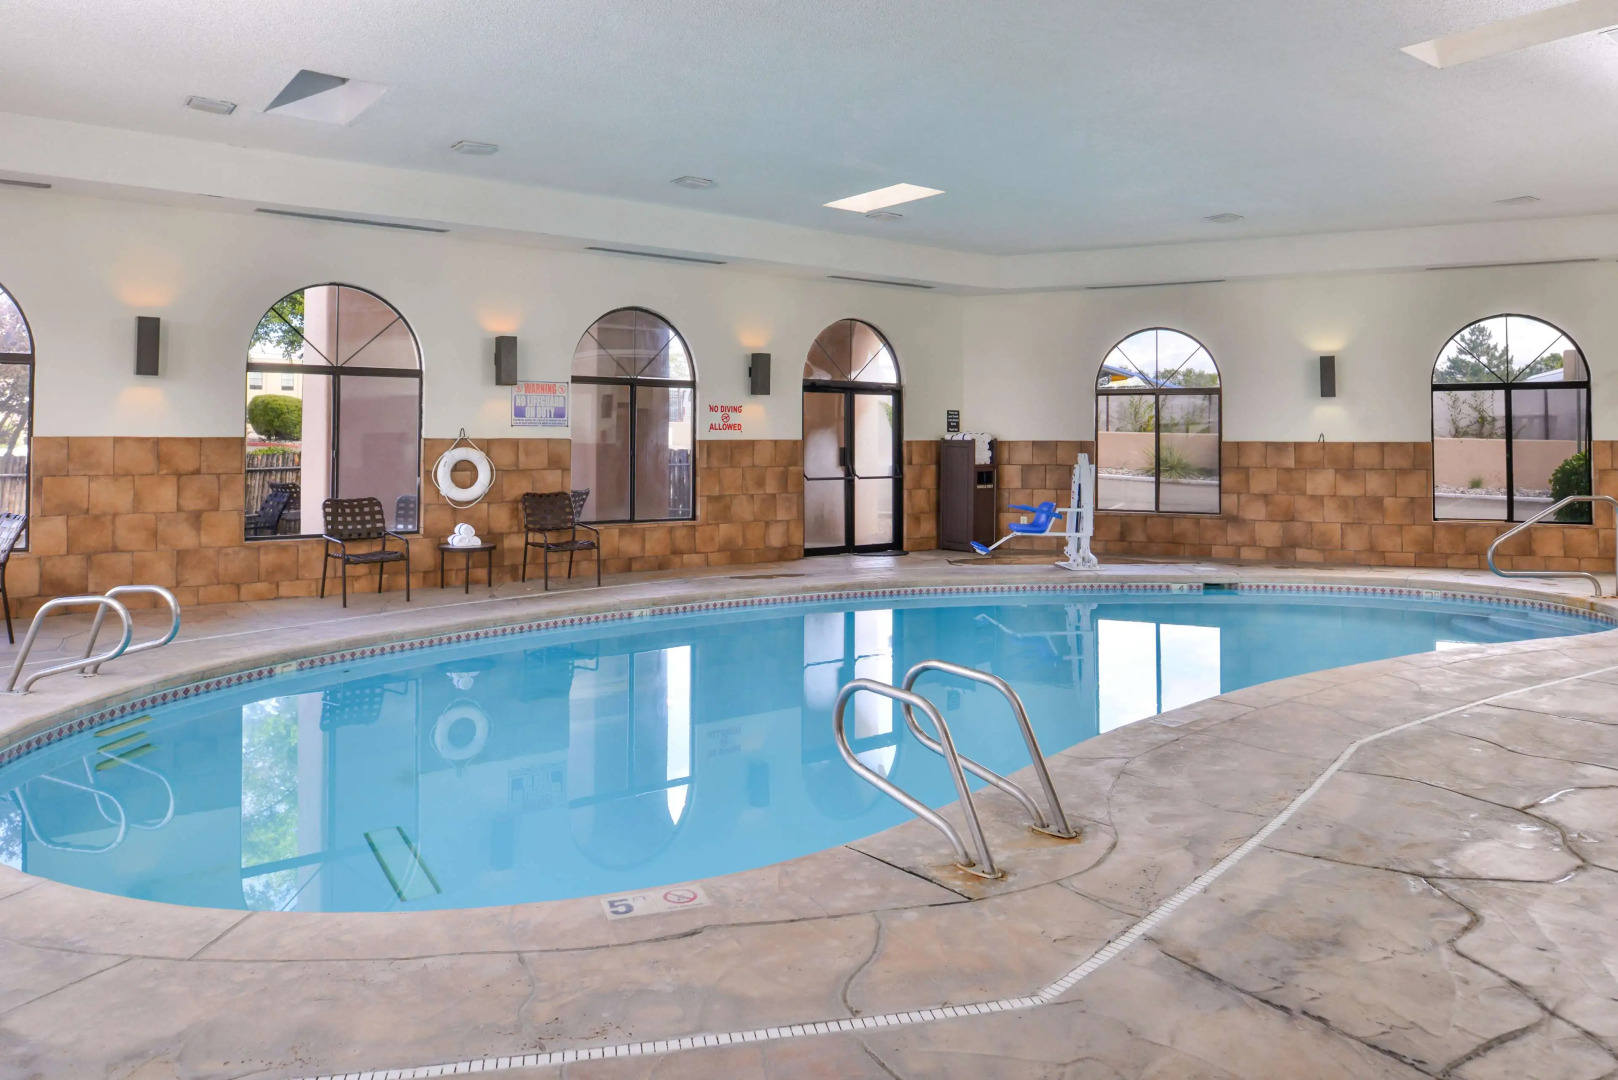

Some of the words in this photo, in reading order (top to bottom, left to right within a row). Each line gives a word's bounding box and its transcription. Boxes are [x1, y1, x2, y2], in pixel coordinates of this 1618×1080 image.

[524, 383, 557, 394] WARNING
[515, 395, 526, 406] NO
[527, 395, 564, 407] LIFEGUARD
[525, 406, 535, 418] ON
[537, 407, 556, 418] DUTY
[720, 405, 742, 413] DIVING
[608, 898, 634, 915] 5
